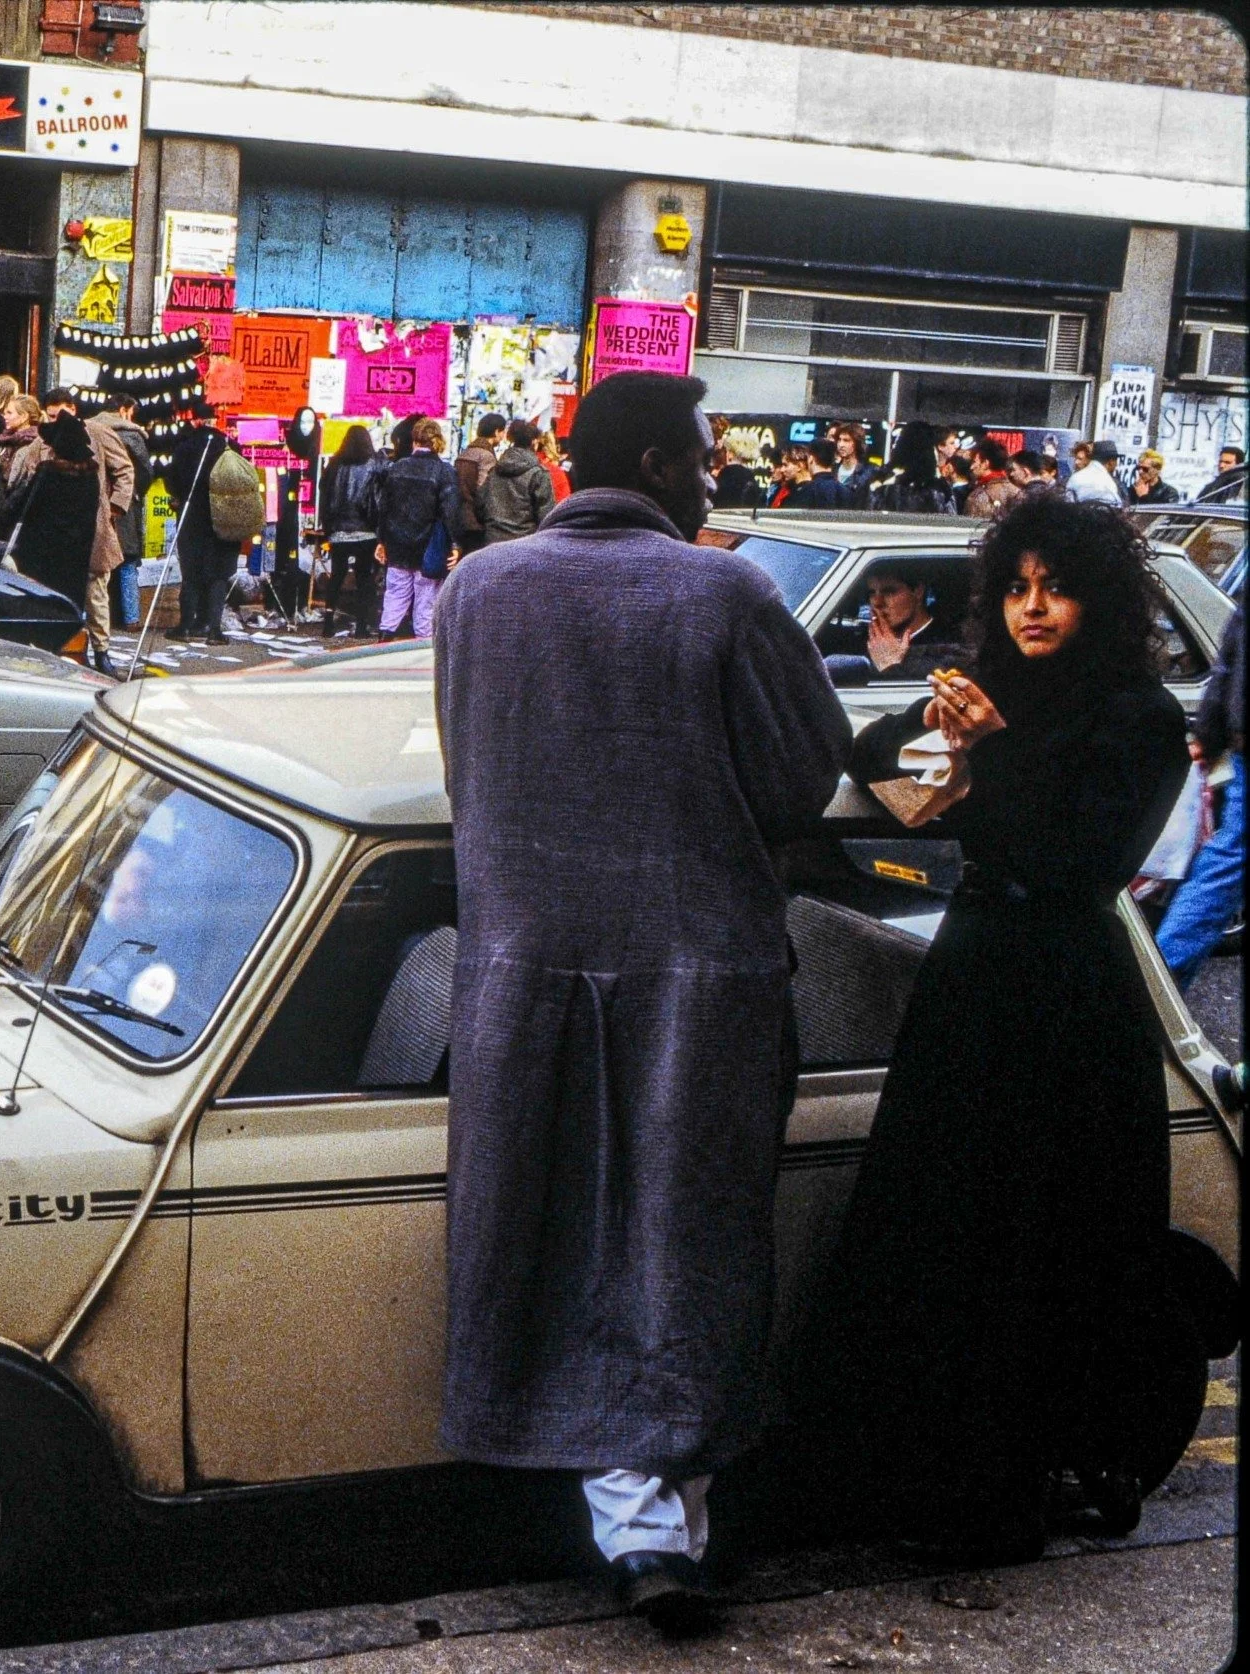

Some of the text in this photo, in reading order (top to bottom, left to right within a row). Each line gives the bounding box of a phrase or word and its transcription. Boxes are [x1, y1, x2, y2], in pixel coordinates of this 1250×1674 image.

[36, 115, 128, 135] BALLROOM
[177, 224, 191, 232] TOM
[172, 279, 222, 310] Salvation
[649, 313, 681, 328] THE
[603, 325, 680, 343] WEDDING
[605, 339, 680, 357] PRESENT
[1112, 381, 1146, 396] KANDA
[1109, 411, 1129, 429] MAN
